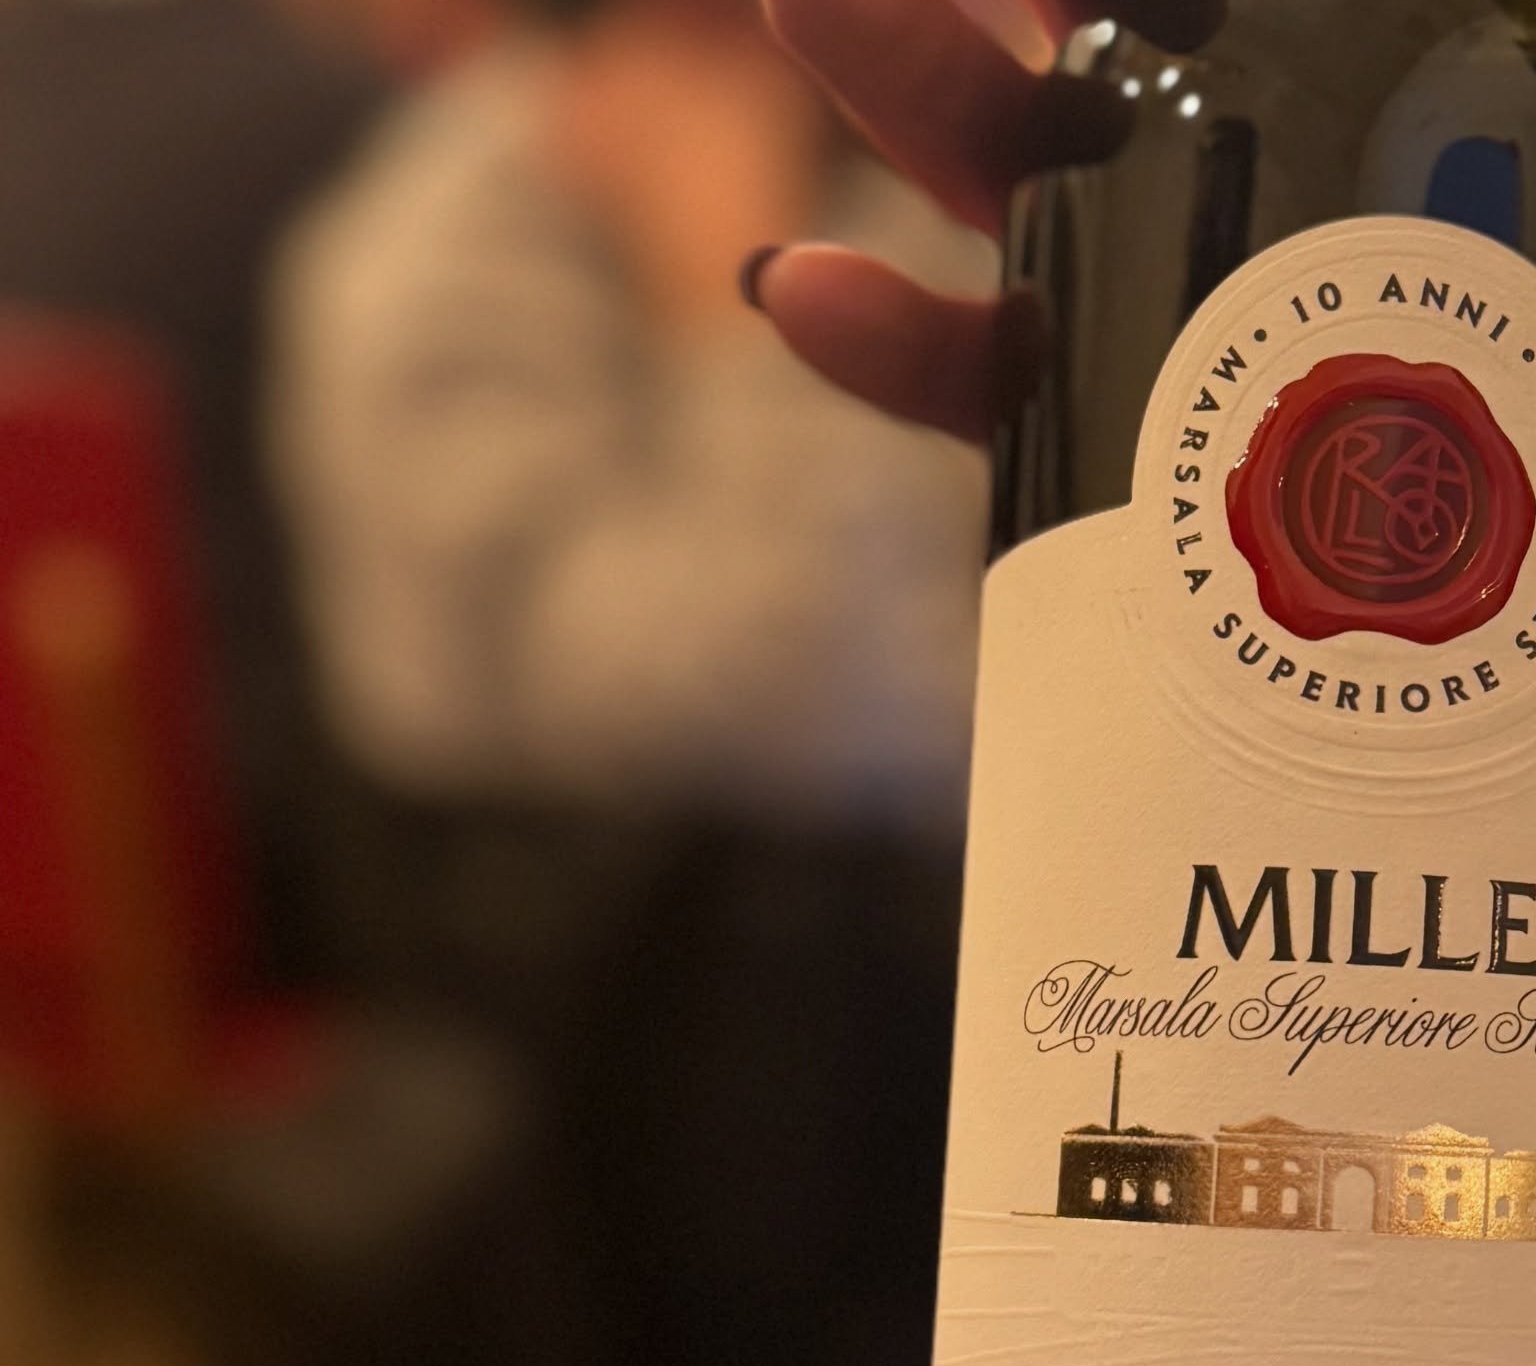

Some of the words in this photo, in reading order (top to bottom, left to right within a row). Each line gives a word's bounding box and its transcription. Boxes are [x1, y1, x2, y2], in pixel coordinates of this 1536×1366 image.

[1290, 281, 1342, 323] 10
[1379, 273, 1511, 342] ANNI
[1172, 344, 1248, 595] MARSALA
[1212, 612, 1500, 714] SUPERIORE
[1023, 958, 1222, 1053] Marsala
[1227, 971, 1480, 1075] Superiore
